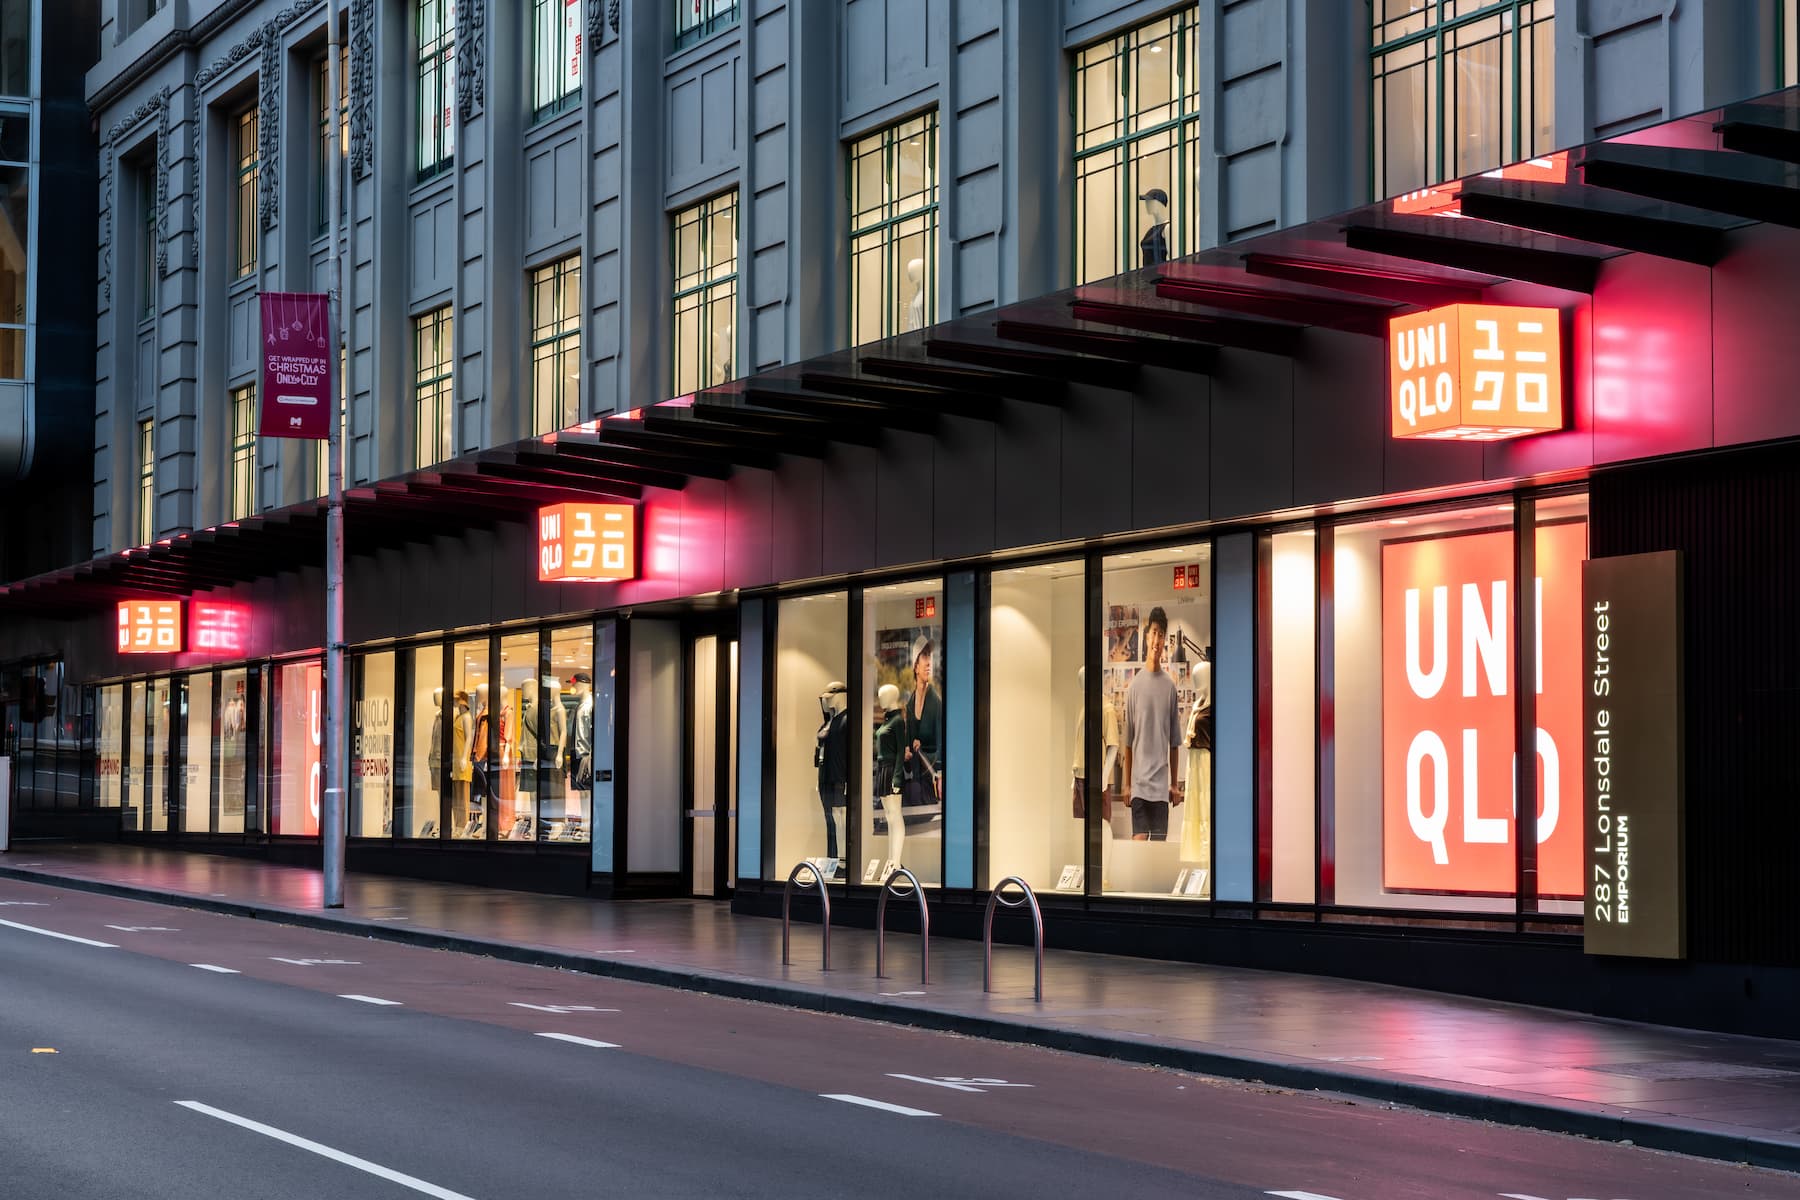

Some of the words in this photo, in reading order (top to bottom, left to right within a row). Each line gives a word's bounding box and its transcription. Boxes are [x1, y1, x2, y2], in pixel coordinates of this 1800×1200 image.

[268, 355, 281, 363] GET
[281, 355, 310, 365] WRAPPED
[310, 357, 319, 365] UP
[1397, 322, 1447, 371] UNI
[1473, 319, 1548, 363] ユニ
[268, 362, 327, 375] CHRISTMAS
[300, 373, 319, 386] CITY
[1399, 372, 1454, 427] QLO
[1471, 370, 1549, 414] クロ
[541, 513, 561, 542] UNI
[573, 512, 625, 538] ユニ
[541, 543, 562, 576] QLO
[571, 543, 625, 569] クロ
[136, 606, 174, 625] ユニ
[1593, 600, 1611, 697] Street
[355, 698, 389, 732] UNIQLO
[1405, 726, 1561, 865] QLO
[1593, 708, 1611, 854] Lonsdale
[1616, 814, 1630, 924] EMPORIUM
[1594, 864, 1611, 923] 287
